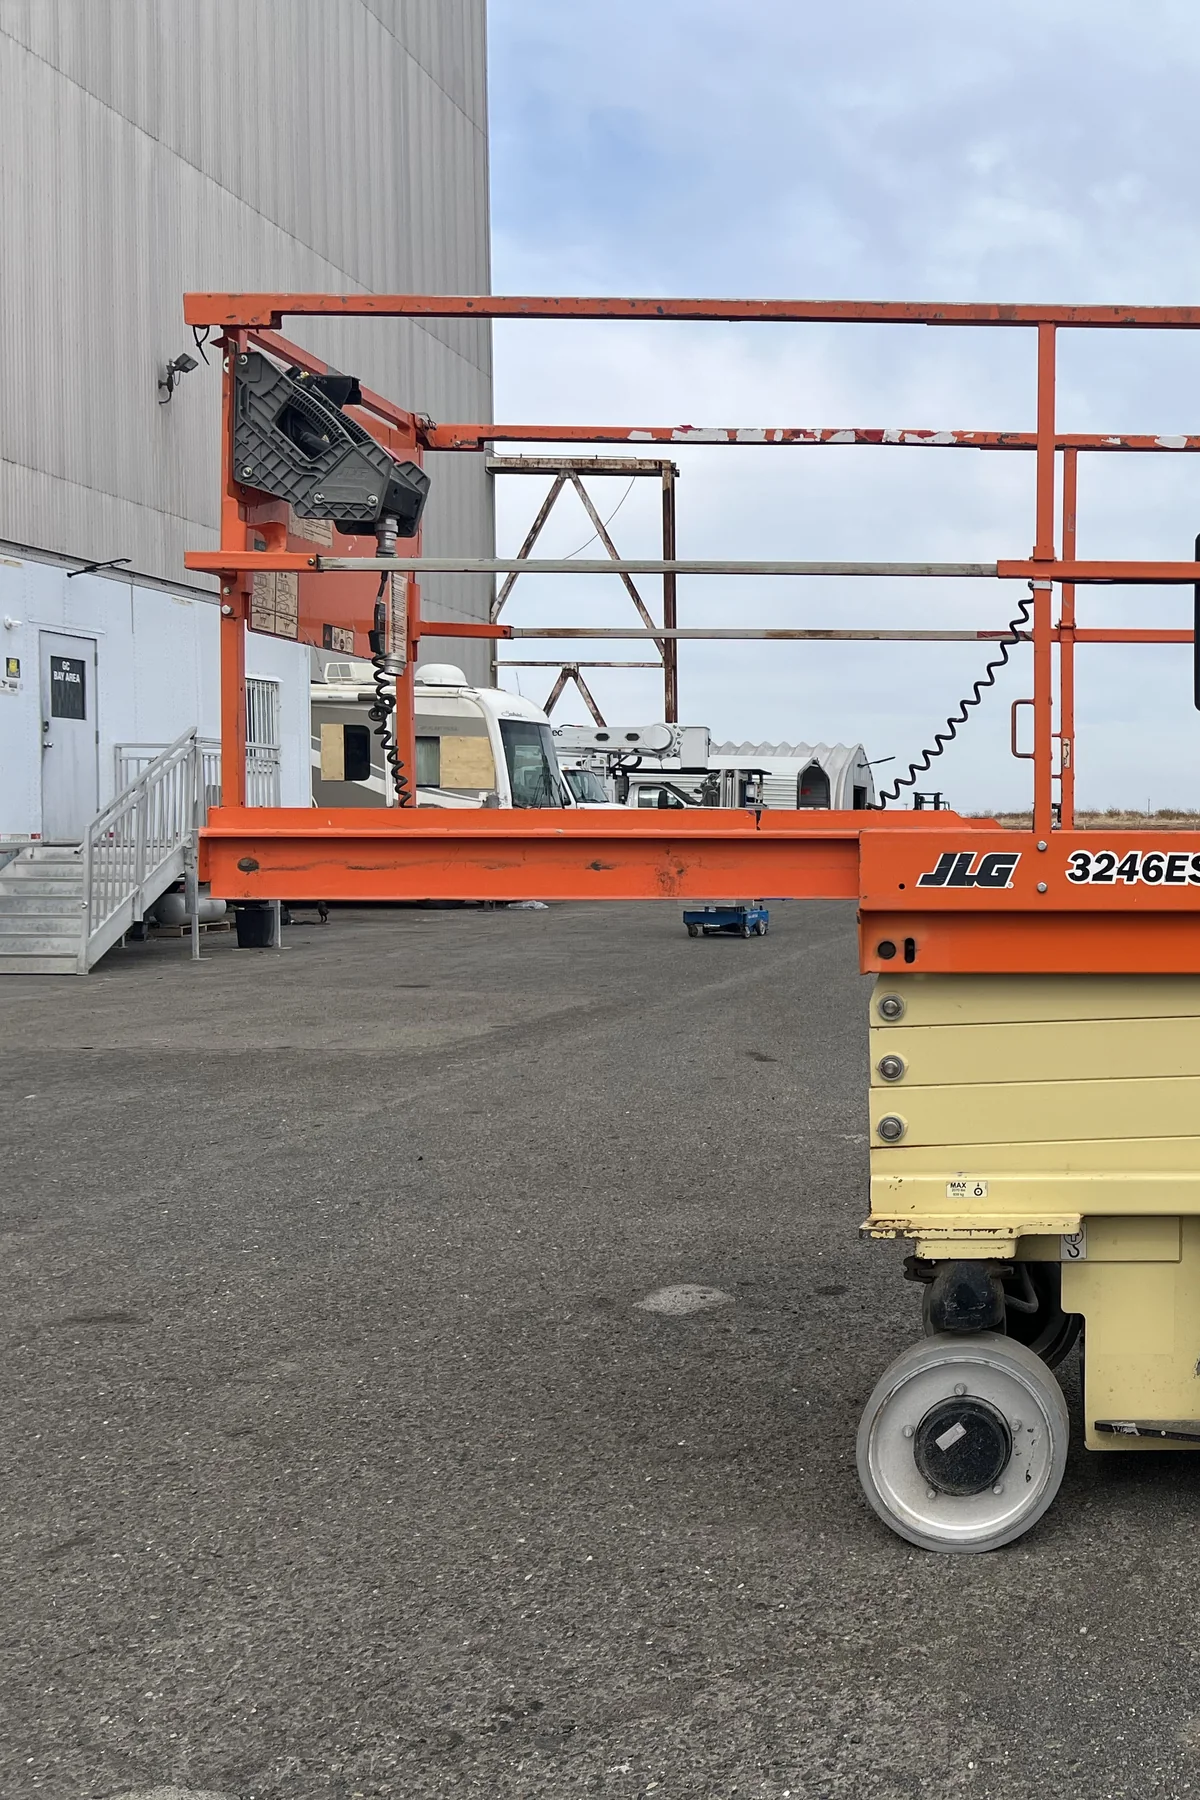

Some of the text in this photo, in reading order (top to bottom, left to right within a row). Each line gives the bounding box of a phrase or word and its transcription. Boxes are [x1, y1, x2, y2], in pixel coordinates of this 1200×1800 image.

[53, 671, 80, 683] BAY AREA
[916, 851, 1022, 887] JLG
